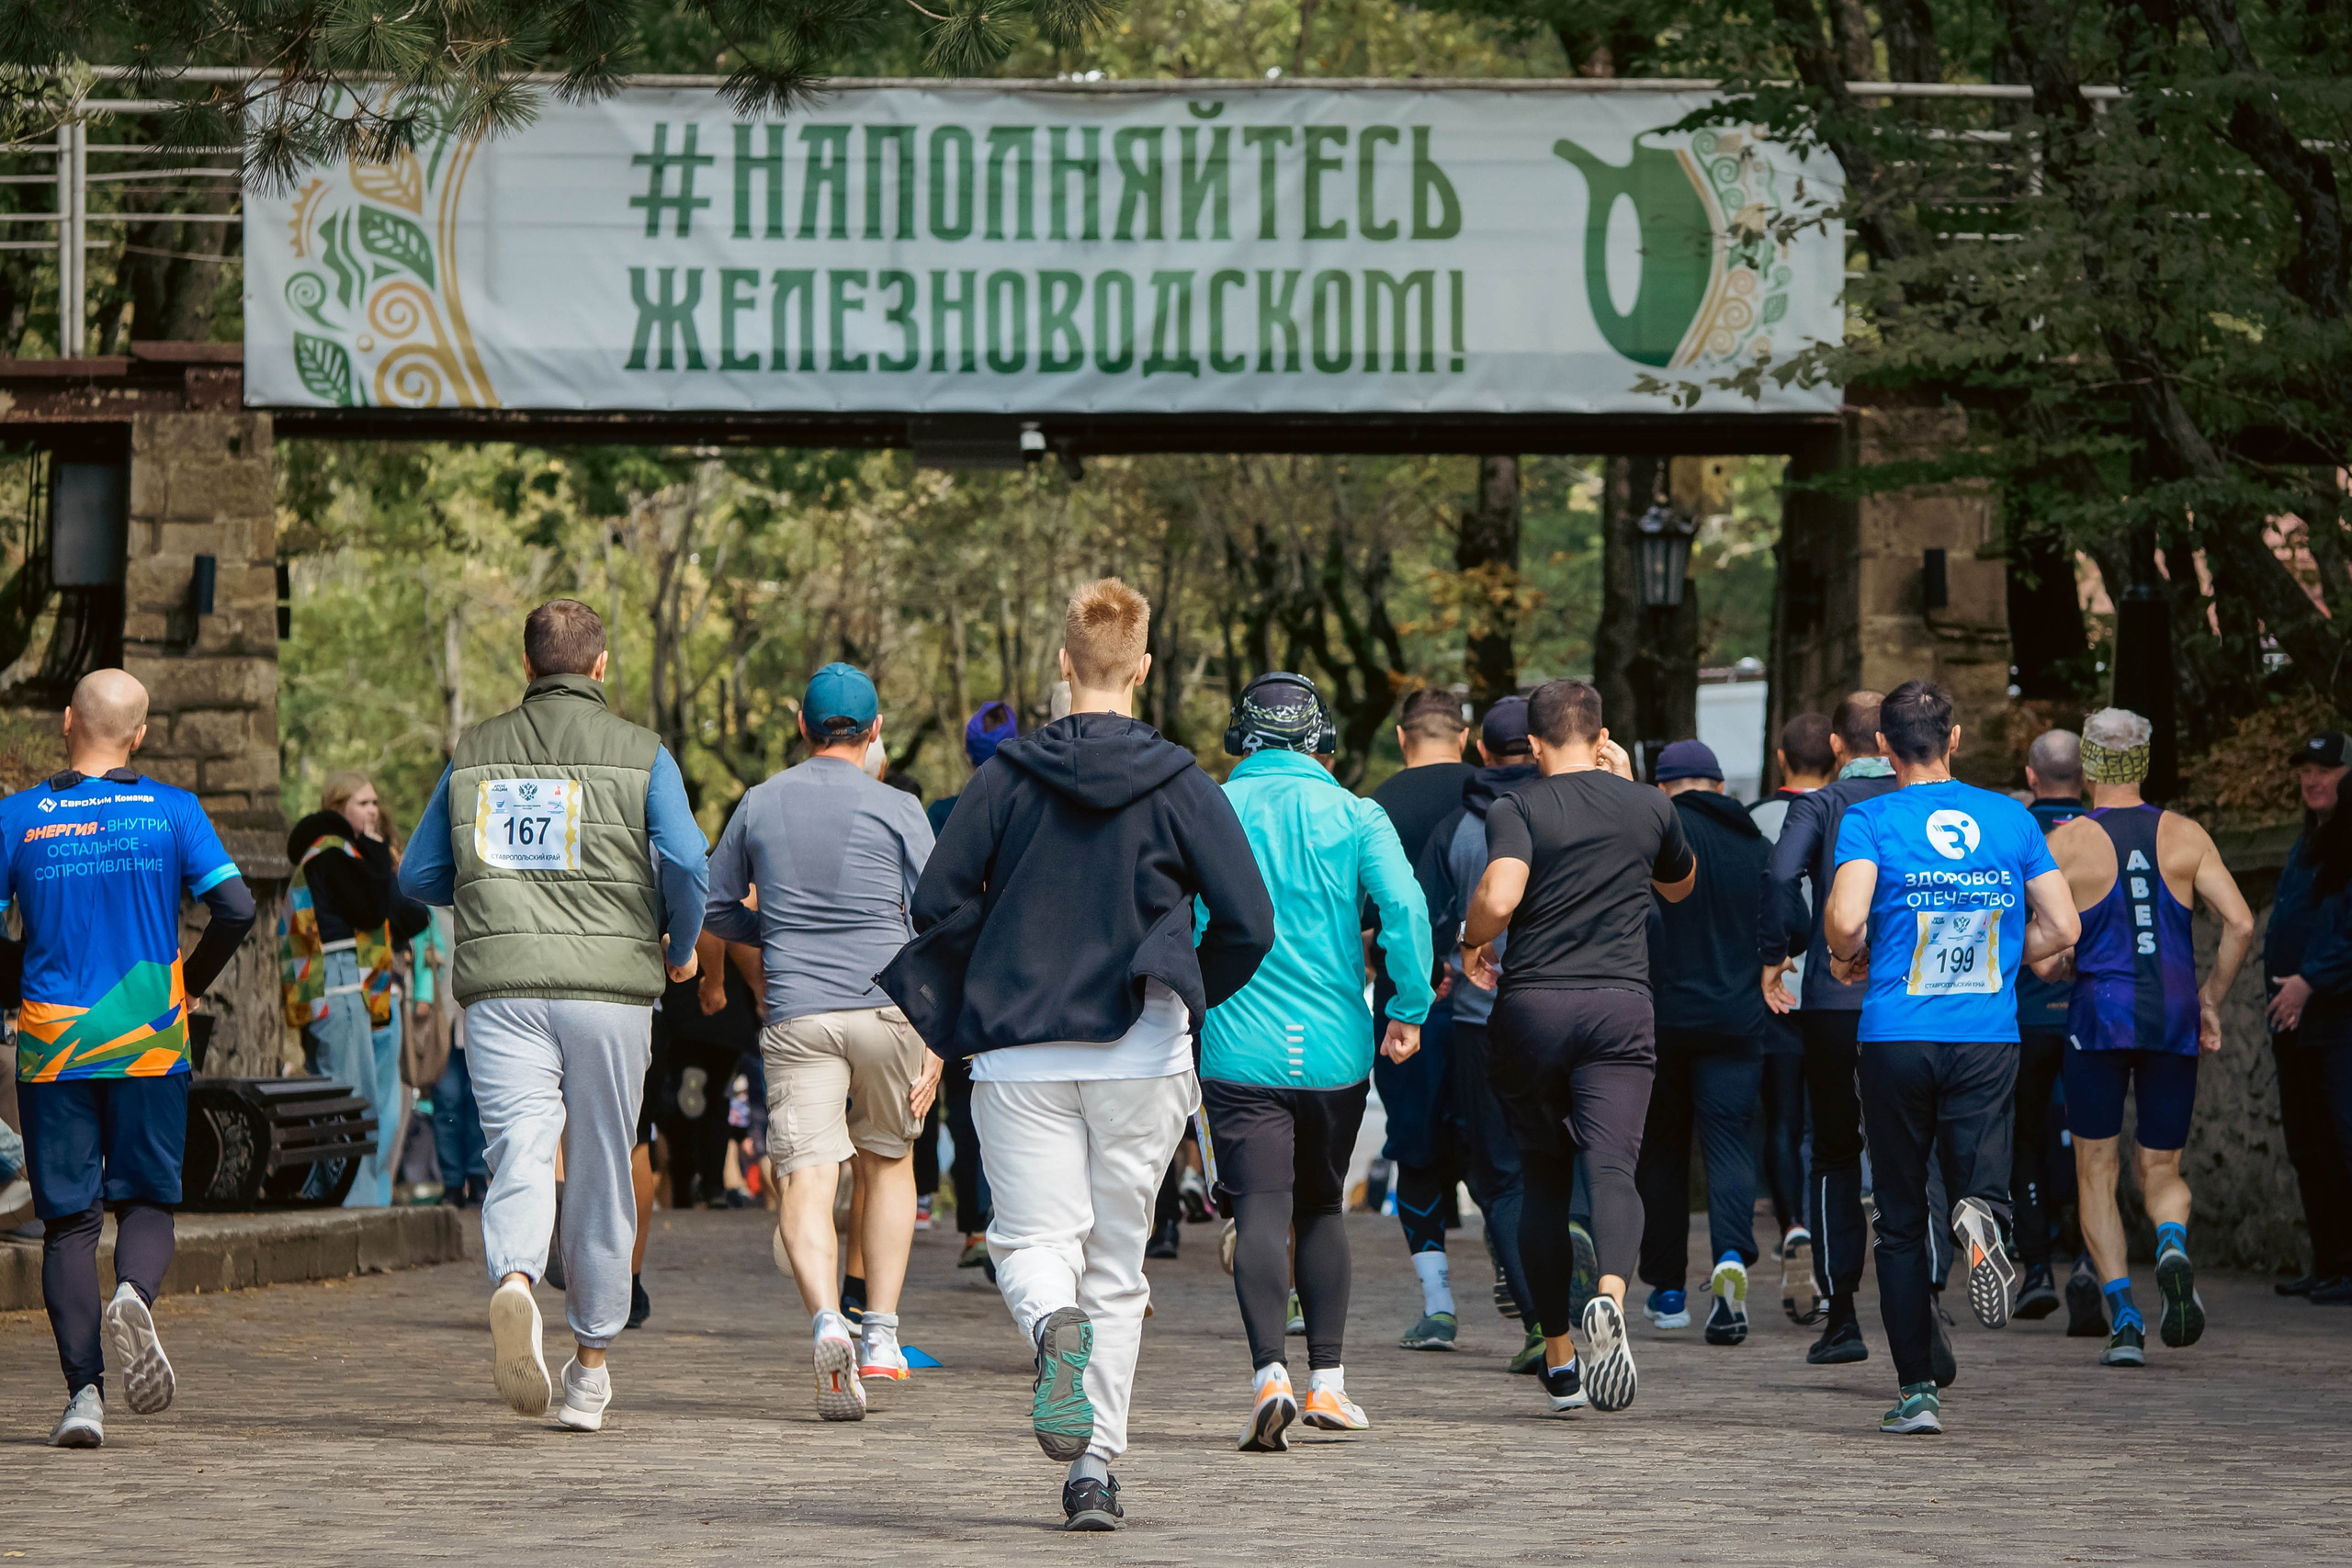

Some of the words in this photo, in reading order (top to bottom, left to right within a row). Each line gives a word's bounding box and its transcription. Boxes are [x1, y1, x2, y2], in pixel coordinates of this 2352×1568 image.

[628, 101, 1463, 243] #НАПОЛНЯЙТЕСЬ
[624, 266, 1466, 378] ЖЕЛЕЗНОВОДСКОМ!
[114, 794, 154, 804] Команда
[24, 821, 98, 843] ЭНЕРГИЯ
[107, 818, 172, 833] ВНУТРИ.
[503, 816, 551, 845] 167
[47, 837, 140, 858] ОСТАЛЬНОЕ
[491, 852, 546, 861] СТАВРОПОЛЬСКИЙ
[546, 852, 560, 861] КРАЙ
[34, 858, 163, 881] СОПРОТИВЛЕНИЕ
[1905, 870, 2012, 887] ЗДОРОВОЕ
[1906, 890, 2015, 908] ОТЕЧЕСТВО
[2126, 849, 2156, 954] ABES
[1936, 945, 1975, 974] 199
